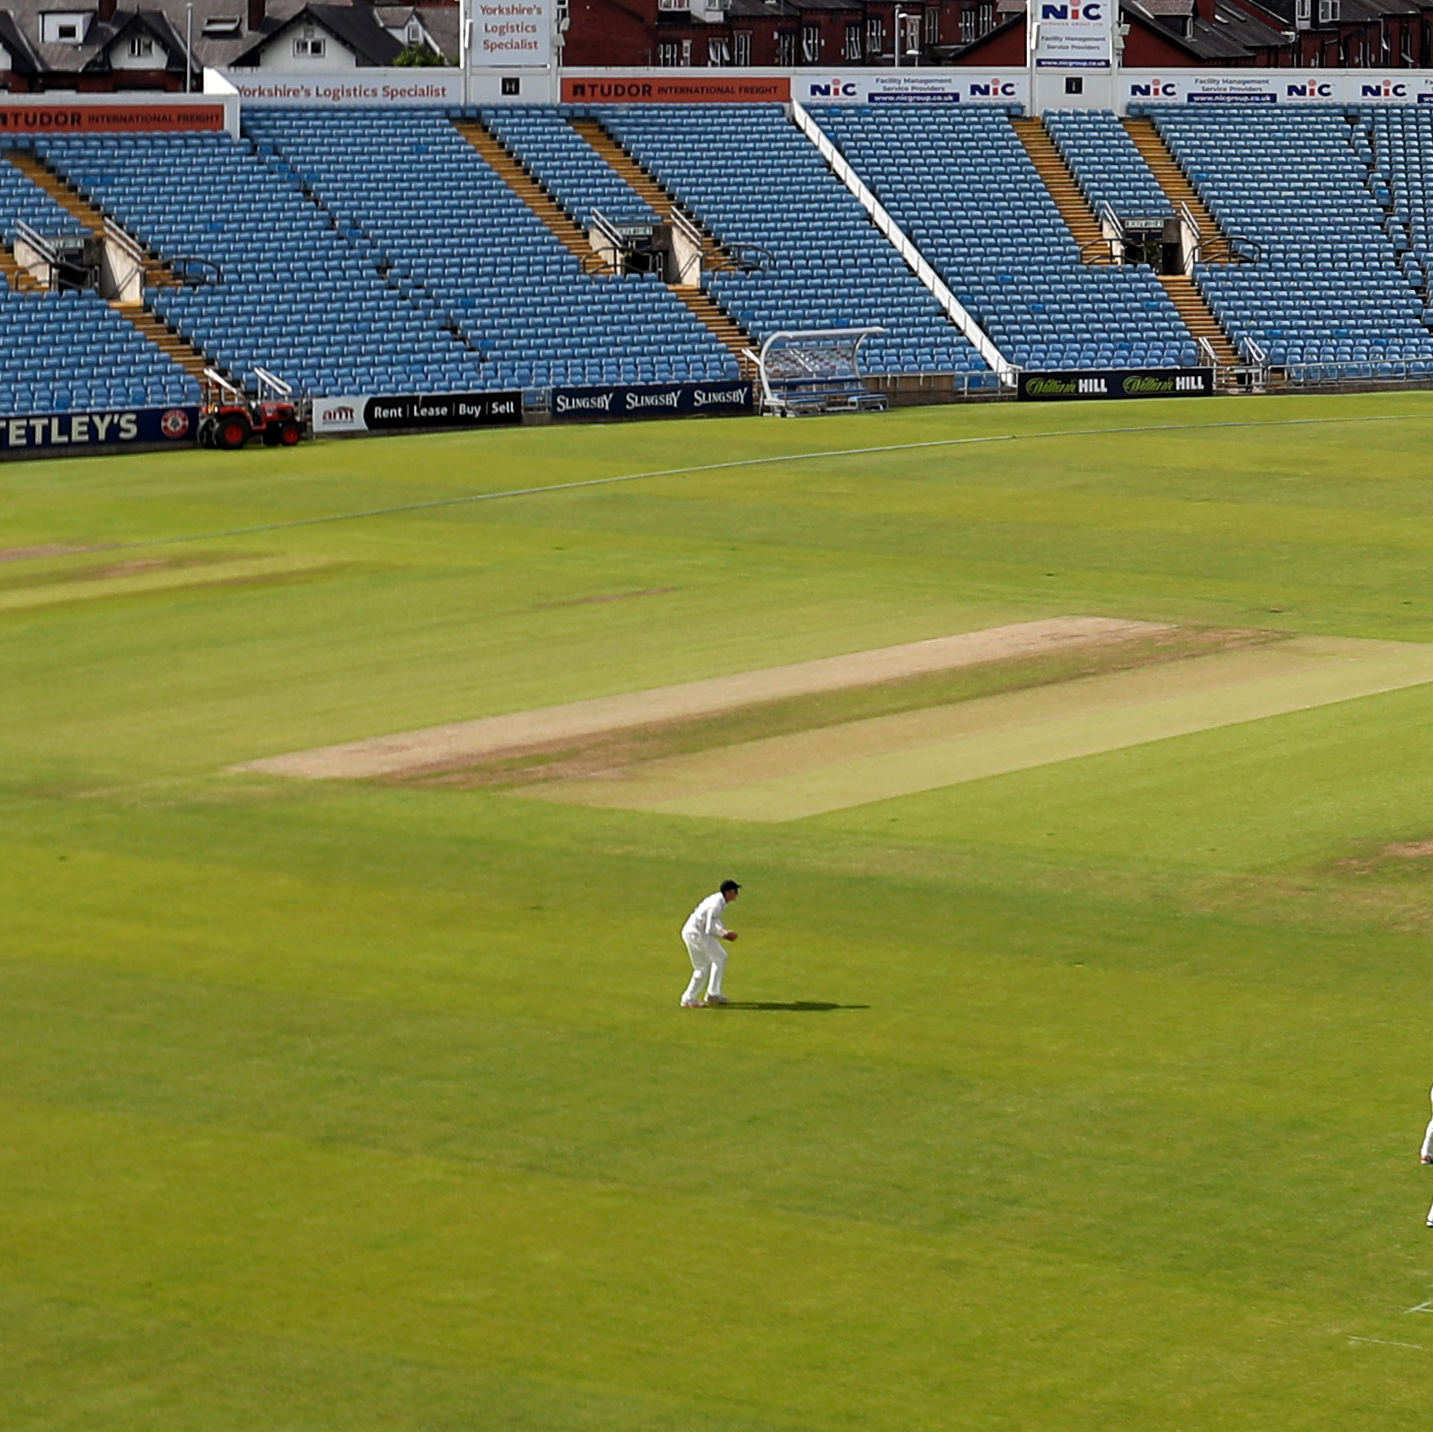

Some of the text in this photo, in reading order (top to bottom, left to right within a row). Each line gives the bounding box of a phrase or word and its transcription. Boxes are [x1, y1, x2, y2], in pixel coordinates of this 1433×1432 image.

[479, 4, 542, 16] Yorkshire's
[484, 22, 537, 37] Logistics
[483, 38, 538, 53] Specialist
[505, 81, 516, 92] H
[875, 77, 952, 85] Facility Management
[238, 84, 447, 101] Yorkshire's Logistics Specialist
[588, 84, 778, 97] TUDOR INTERNATIONAL FREIGHT
[874, 94, 954, 103] www.nicgroup.co.uk
[1193, 94, 1271, 103] www.nicgroup.co.uk
[11, 112, 220, 127] TUDOR INTERNATIONAL FREIGHT
[1025, 377, 1108, 395] William HILL
[1123, 375, 1205, 394] William HILL
[556, 392, 614, 413] SLINGSBY
[625, 389, 682, 410] SLINGSBY
[693, 386, 749, 407] SLINGSBY
[322, 407, 355, 421] amt
[374, 401, 515, 418] Rent Lease Buy Sell
